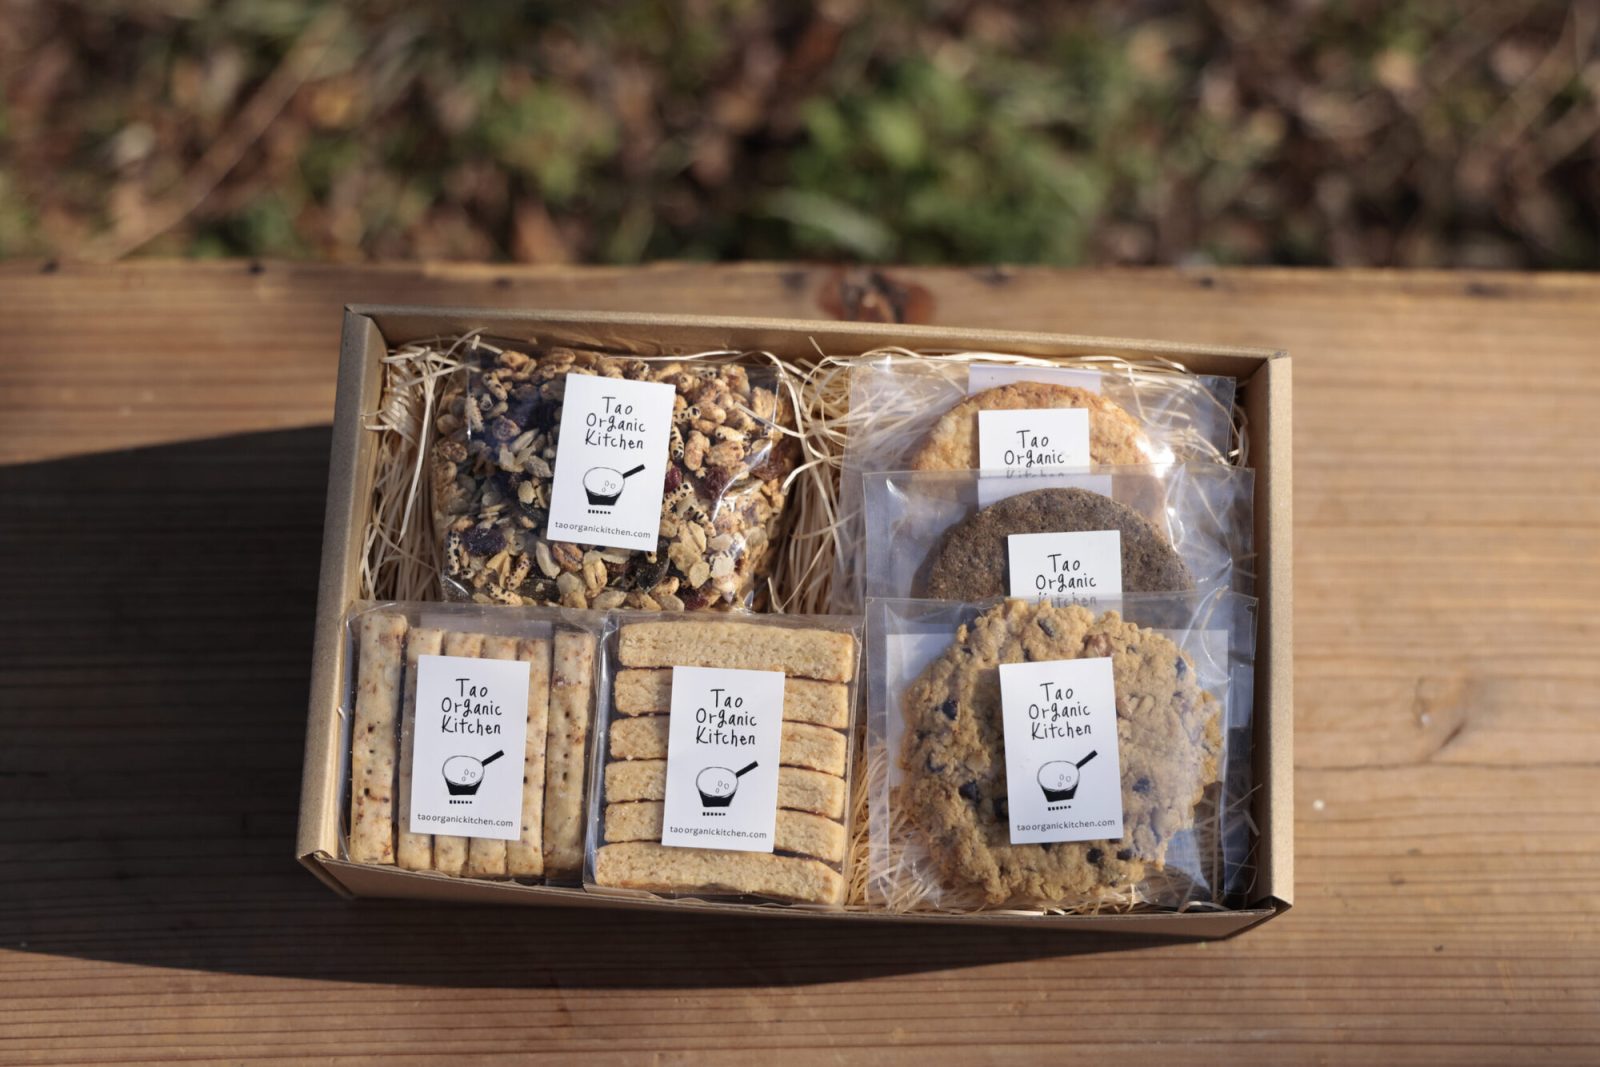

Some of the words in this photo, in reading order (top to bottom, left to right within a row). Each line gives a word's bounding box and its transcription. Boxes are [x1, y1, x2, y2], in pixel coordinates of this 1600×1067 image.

[602, 396, 633, 416] Tao
[586, 412, 646, 433] Organic
[585, 428, 644, 450] Kitchen
[1016, 429, 1049, 448] Tao
[1004, 450, 1065, 468] Organic
[555, 521, 651, 539] taoorganickitchen.com
[1047, 554, 1080, 573] Tao
[1036, 573, 1096, 592] Organic
[455, 678, 488, 697] Tao
[1040, 682, 1074, 701] Tao
[441, 697, 502, 718] Organic
[710, 688, 743, 708] Tao
[696, 708, 757, 728] Organic
[1028, 702, 1090, 722] Organic
[441, 714, 501, 736] Kitchen
[1032, 722, 1092, 740] Kitchen
[696, 725, 756, 747] Kitchen
[417, 813, 513, 827] taoorganickitchen.com
[1017, 819, 1115, 832] taoorganickitchen.com
[670, 826, 767, 839] taoorganickitchen.com
